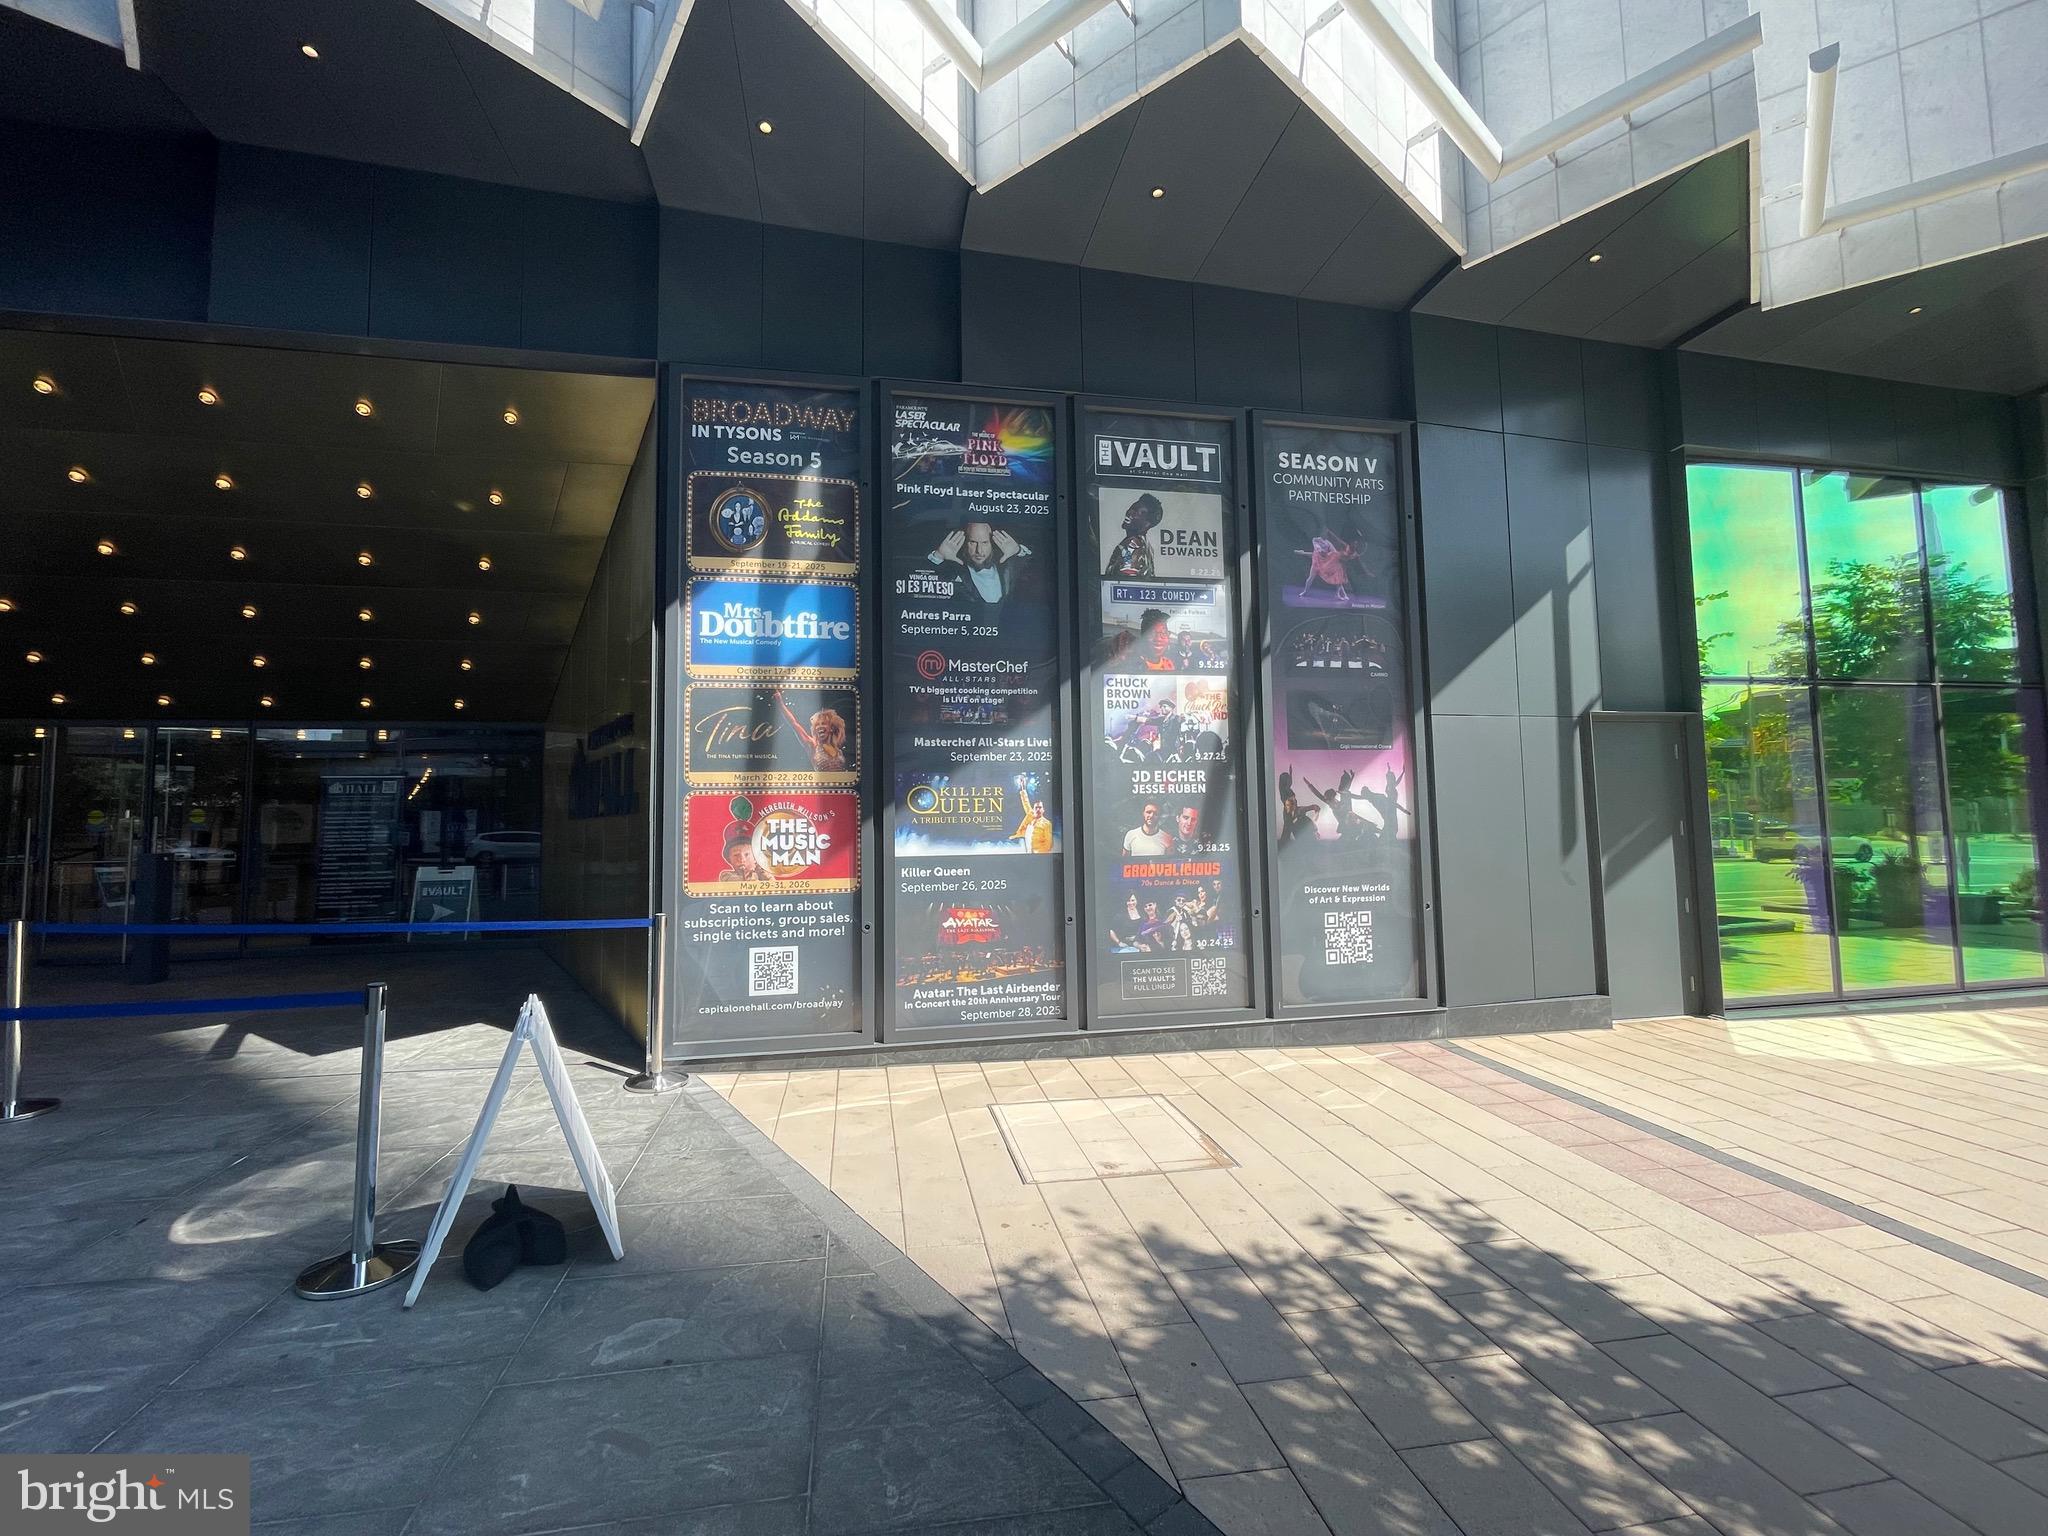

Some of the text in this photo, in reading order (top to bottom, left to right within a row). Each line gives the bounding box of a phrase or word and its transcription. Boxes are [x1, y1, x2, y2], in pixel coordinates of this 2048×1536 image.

[691, 399, 855, 432] BROADWAY
[895, 410, 926, 420] LASER
[895, 420, 961, 432] SPECTACULAR
[691, 425, 710, 438] IN
[714, 426, 782, 441] TYSONS
[968, 439, 1003, 452] PINK
[727, 447, 822, 469] Season 5
[964, 451, 1007, 466] FLOYD
[1113, 441, 1216, 473] VAULT
[1278, 452, 1377, 474] SEASON V
[1273, 473, 1385, 491] COMMUNITY ARTS
[896, 483, 1049, 502] Pink Floyd Laser Spectacular
[1288, 490, 1371, 505] PARTNERSHIP
[794, 499, 823, 509] The
[968, 503, 1049, 515] August 23, 2025
[777, 509, 845, 526] Addams
[784, 525, 840, 547] Family
[1160, 529, 1217, 547] DEAN
[1160, 546, 1218, 558] EDWARDS
[731, 559, 775, 571] September
[805, 563, 826, 571] 2025
[896, 580, 906, 594] SI
[907, 580, 920, 593] ES
[1116, 588, 1196, 601] RT. 123 COMEDY
[724, 602, 765, 619] Mrs.
[901, 610, 971, 621] Andres Parra
[700, 611, 850, 641] Doubtfire
[901, 624, 999, 636] September 5, 2025
[755, 639, 782, 647] Comedy
[948, 659, 1029, 673] MasterChef
[1198, 660, 1225, 669] 9.5.25
[737, 667, 771, 675] October
[801, 667, 822, 676] 2025
[942, 675, 997, 683] ALL-STARS
[1106, 678, 1148, 687] CHUCK
[927, 686, 957, 696] biggest
[958, 687, 990, 696] cooking
[991, 687, 1038, 697] competition
[1106, 689, 1150, 698] BROWN
[951, 696, 968, 704] LIVE
[980, 697, 1005, 706] stage!
[1107, 700, 1139, 710] BAND
[694, 706, 784, 752] Tina
[914, 737, 1052, 748] Masterchef All-Stars Live!
[950, 752, 1053, 763] September 23, 2025
[1195, 752, 1226, 761] 9.27.25
[734, 773, 760, 782] March
[792, 773, 814, 781] 2026
[1132, 770, 1206, 782] JD EICHER
[940, 786, 1004, 797] KILLER
[1132, 783, 1206, 794] JESSE RUBEN
[907, 785, 1004, 814] QUEEN
[767, 819, 808, 834] THE
[960, 816, 971, 824] TO
[972, 816, 1003, 825] QUEEN
[1198, 843, 1230, 852] 9.28.25
[772, 850, 821, 867] MAN
[901, 867, 971, 878] Killer Queen
[1123, 862, 1221, 878] GROOVALICIOUS
[740, 882, 757, 891] May
[789, 881, 810, 889] 2026
[901, 880, 1007, 894] September 26, 2025
[1154, 879, 1174, 887] Dance
[1304, 885, 1340, 894] Discover
[1361, 883, 1391, 892] Worlds
[429, 886, 465, 896] VAULT
[1319, 896, 1332, 904] Art
[1342, 894, 1386, 904] Expression
[709, 900, 833, 914] Scan to learn about
[684, 913, 853, 929] subscriptions, group sales,
[942, 917, 999, 928] AVATAR
[693, 926, 845, 943] single tickets and more!
[1196, 937, 1234, 948] 10.24.25
[913, 983, 1061, 1000] Avatar: The Last Airbender
[1151, 983, 1176, 991] LINEUP
[699, 999, 844, 1015] capitalonehall.com/broadway
[904, 994, 1061, 1010] in Concert the 20th Anniversary Tour
[960, 1006, 1061, 1022] September 28, 2025
